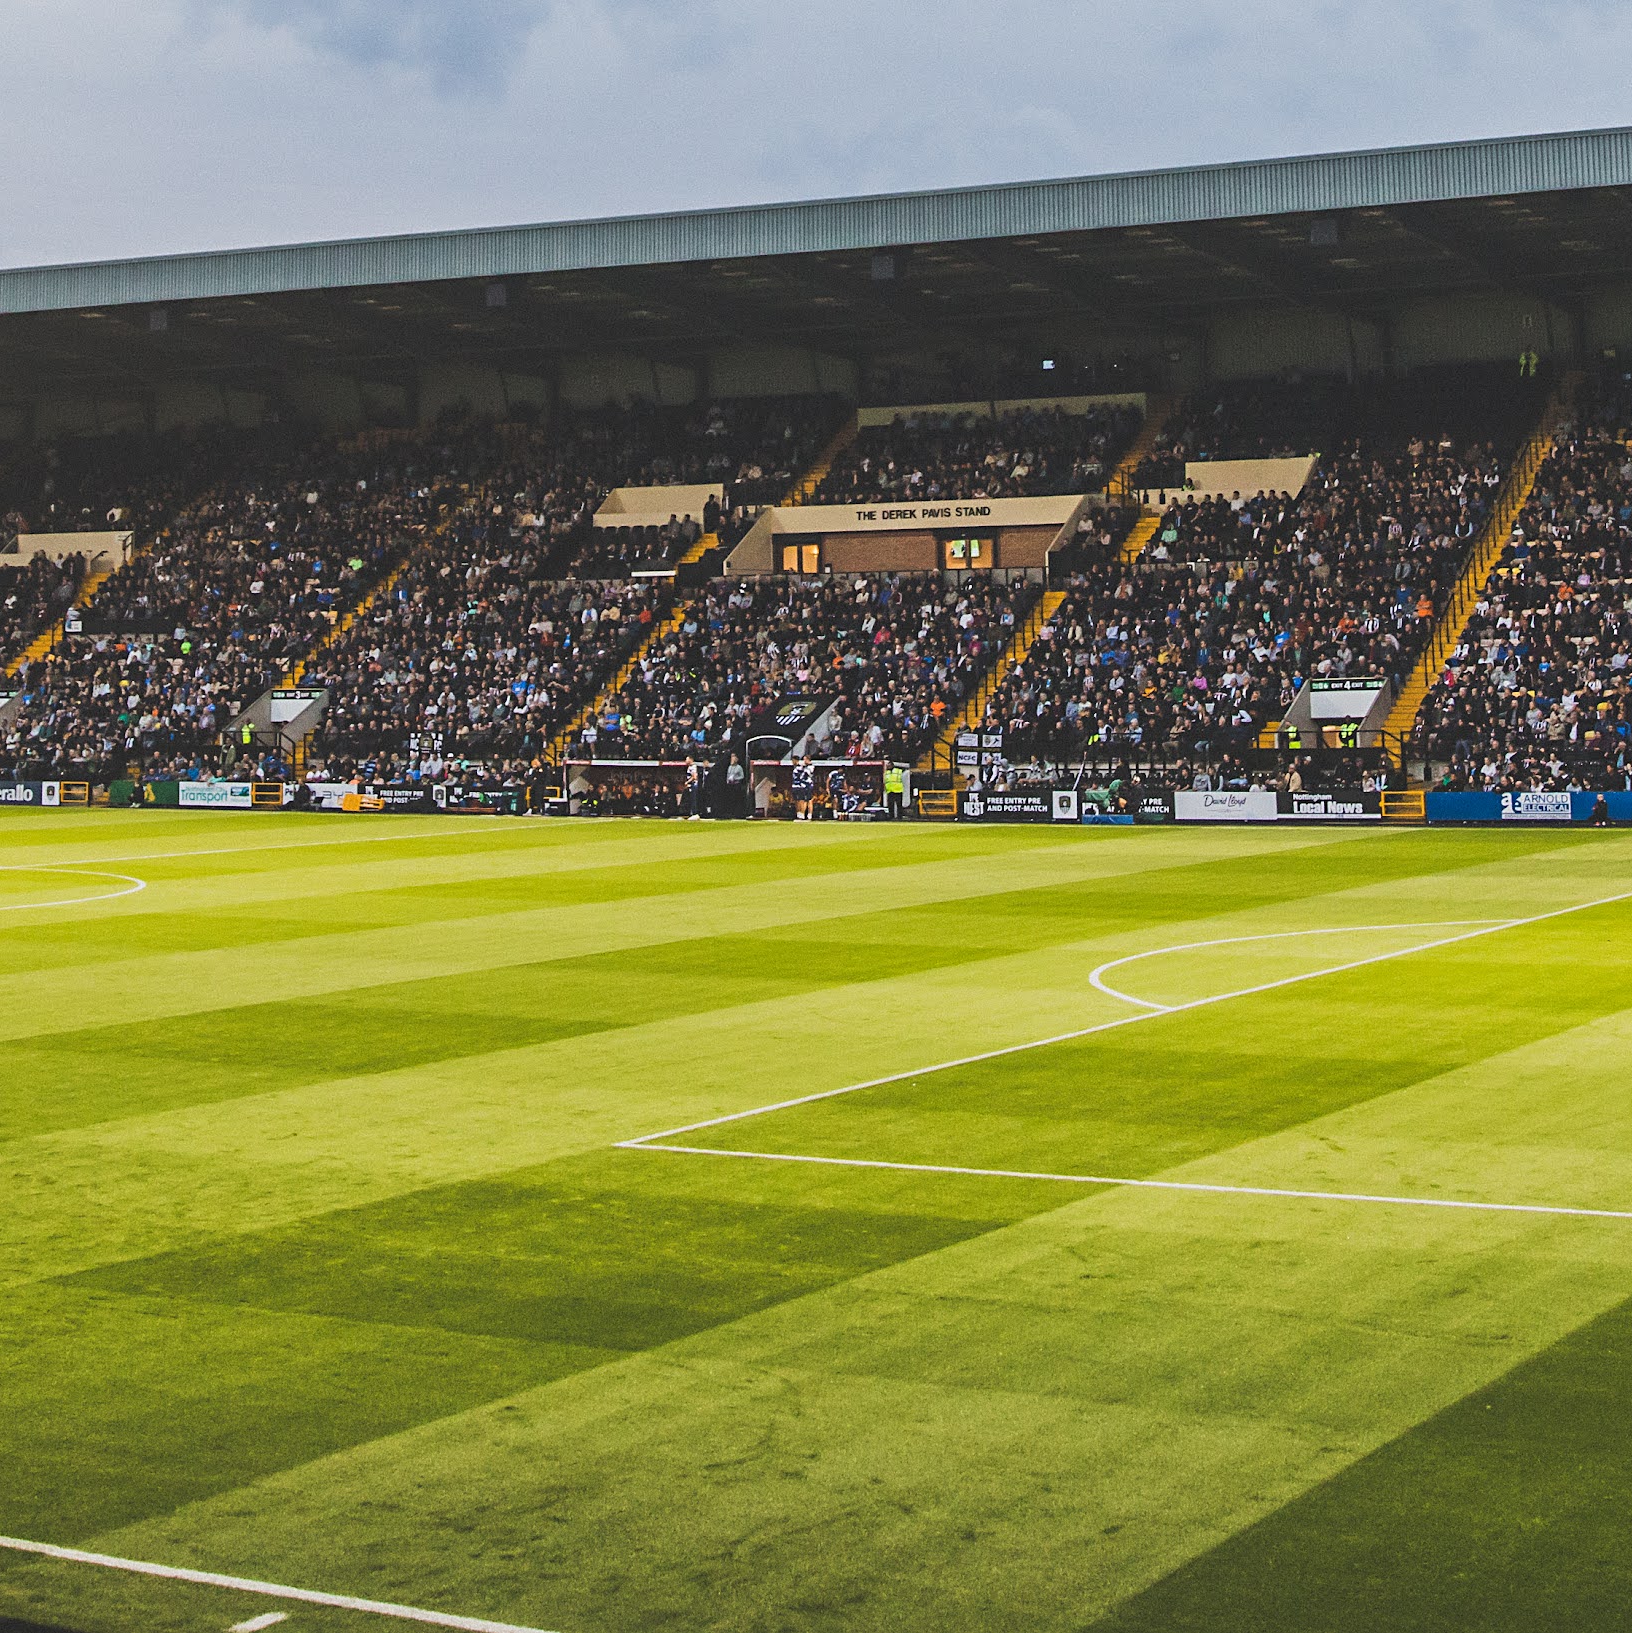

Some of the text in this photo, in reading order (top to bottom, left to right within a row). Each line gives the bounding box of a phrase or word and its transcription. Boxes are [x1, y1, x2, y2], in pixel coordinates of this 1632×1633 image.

[856, 506, 991, 521] THE DEREK PAVIS STAND
[1344, 680, 1351, 690] 4
[181, 789, 229, 803] Transport
[987, 797, 1042, 805] FREE ENTRY PRE
[1203, 794, 1247, 808] David Lloyd
[1293, 793, 1333, 802] Nottingham
[1524, 794, 1569, 804] ARNOLD
[987, 804, 1048, 813] AND POST-MATCH
[1293, 801, 1364, 814] Local News
[1523, 804, 1569, 812] ELECTRICAL
